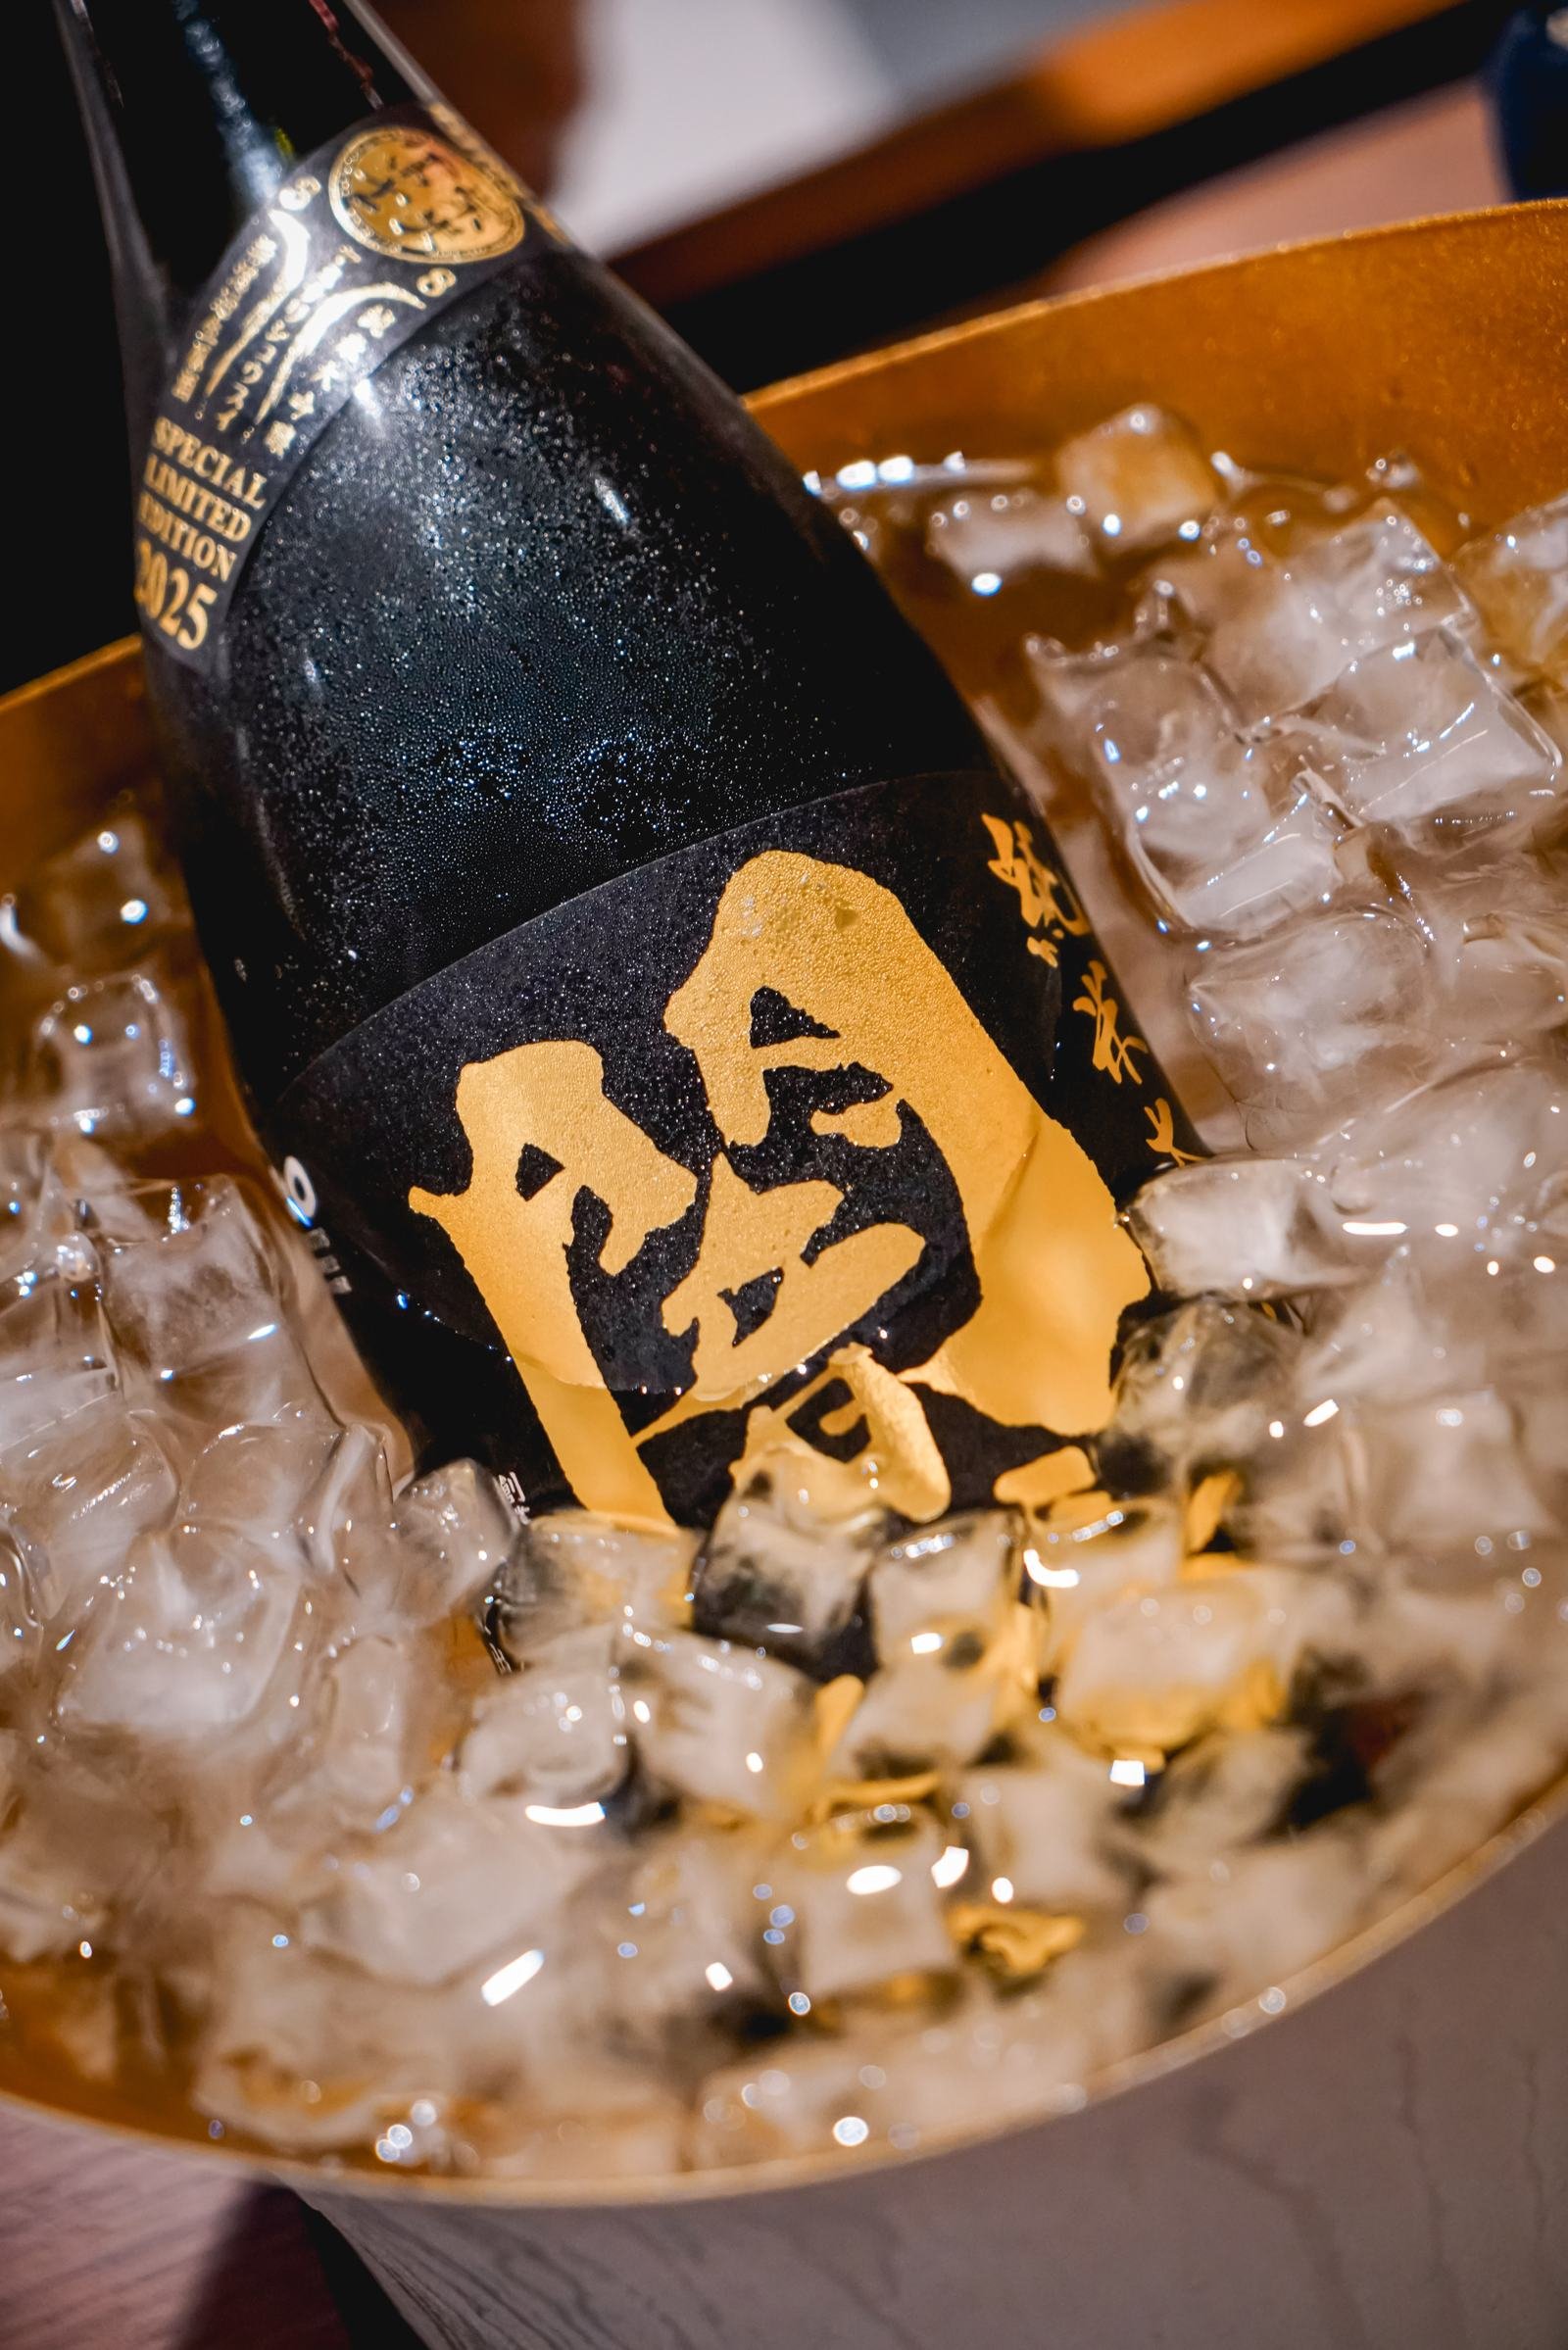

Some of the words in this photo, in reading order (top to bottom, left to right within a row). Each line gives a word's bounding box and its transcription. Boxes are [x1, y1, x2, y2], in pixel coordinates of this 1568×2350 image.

[144, 454, 252, 543] LIMITED
[151, 416, 268, 510] SPECIAL
[137, 491, 238, 582] EDITION
[133, 540, 219, 651] 2025
